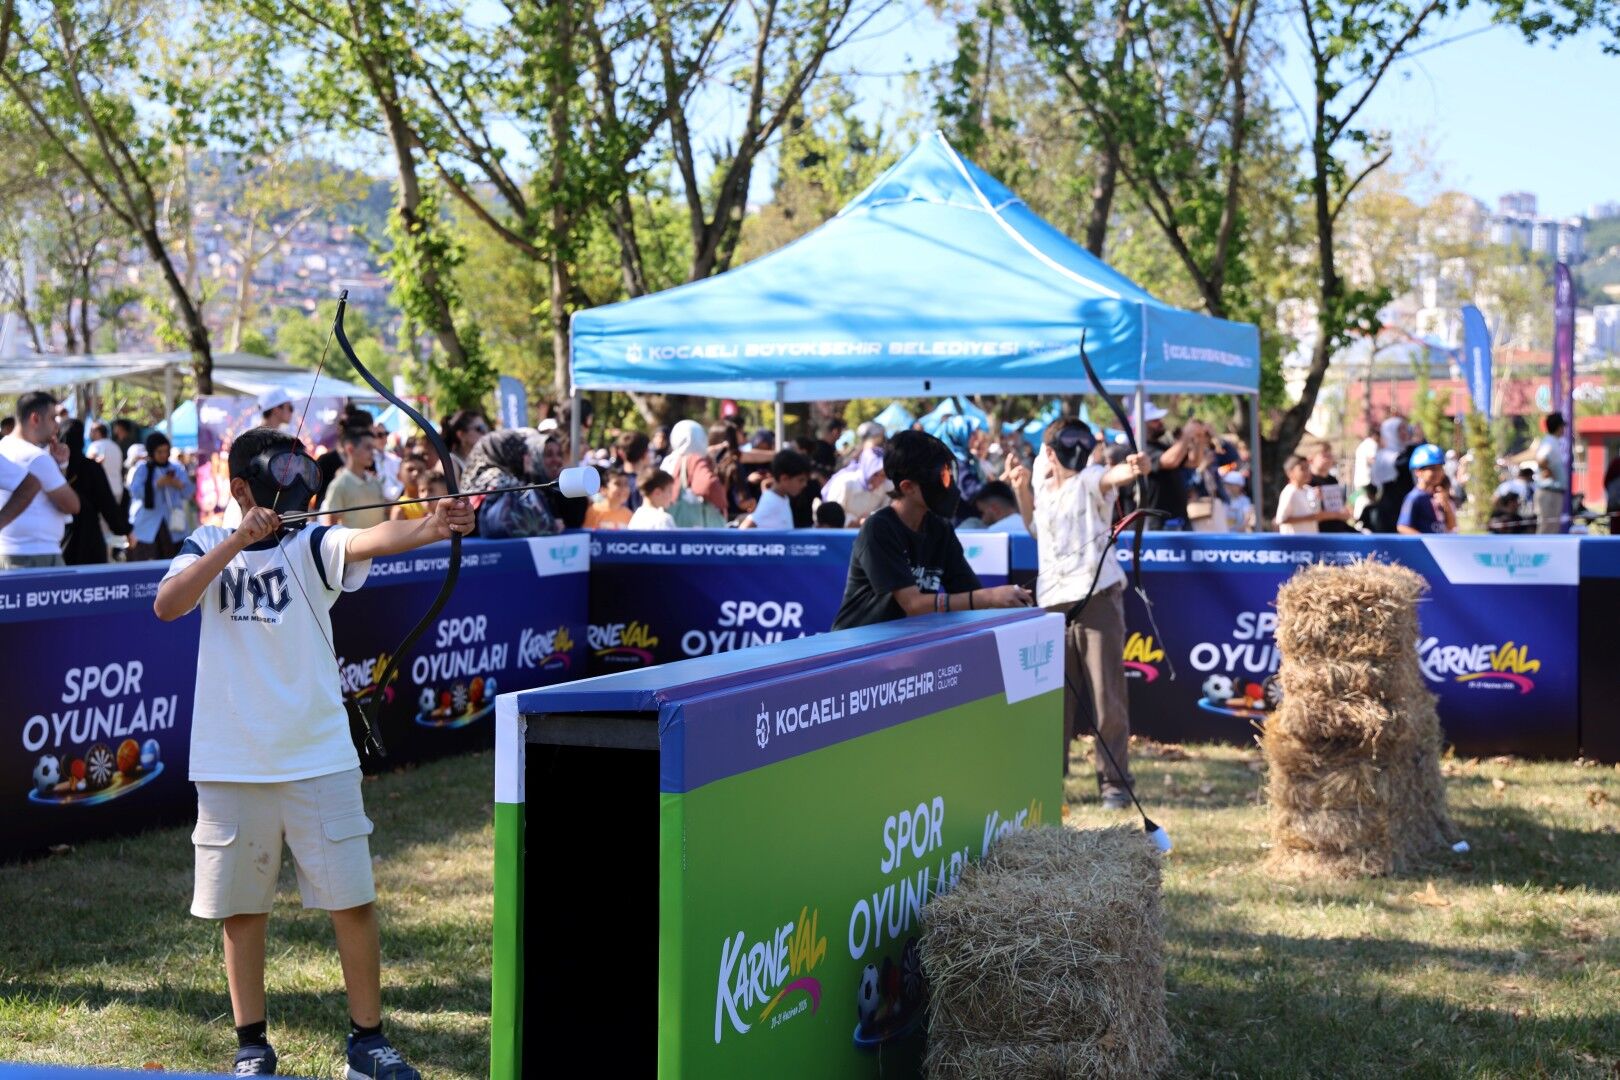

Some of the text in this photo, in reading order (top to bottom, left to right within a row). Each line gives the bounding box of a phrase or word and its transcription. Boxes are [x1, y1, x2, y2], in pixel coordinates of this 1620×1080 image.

[369, 560, 413, 576] OCAELİ
[606, 542, 677, 556] KOCAELİ
[26, 584, 130, 607] BÜYÜKŞEHİR
[219, 566, 293, 615] NYC
[435, 615, 487, 648] SPOR
[587, 619, 659, 650] RNEVAL
[717, 600, 803, 628] SPOR
[1232, 611, 1279, 640] SP
[412, 643, 508, 685] OYUNLARI
[517, 625, 574, 668] KARNEVAL
[1415, 637, 1541, 682] KARNEVAL
[61, 660, 144, 704] SPOR
[22, 695, 178, 752] OYUNLARI
[775, 671, 934, 736] KOCAELİ BÜYÜKŞEHİR
[880, 796, 944, 874] SPOR
[715, 905, 827, 1044] KARNEVAL
